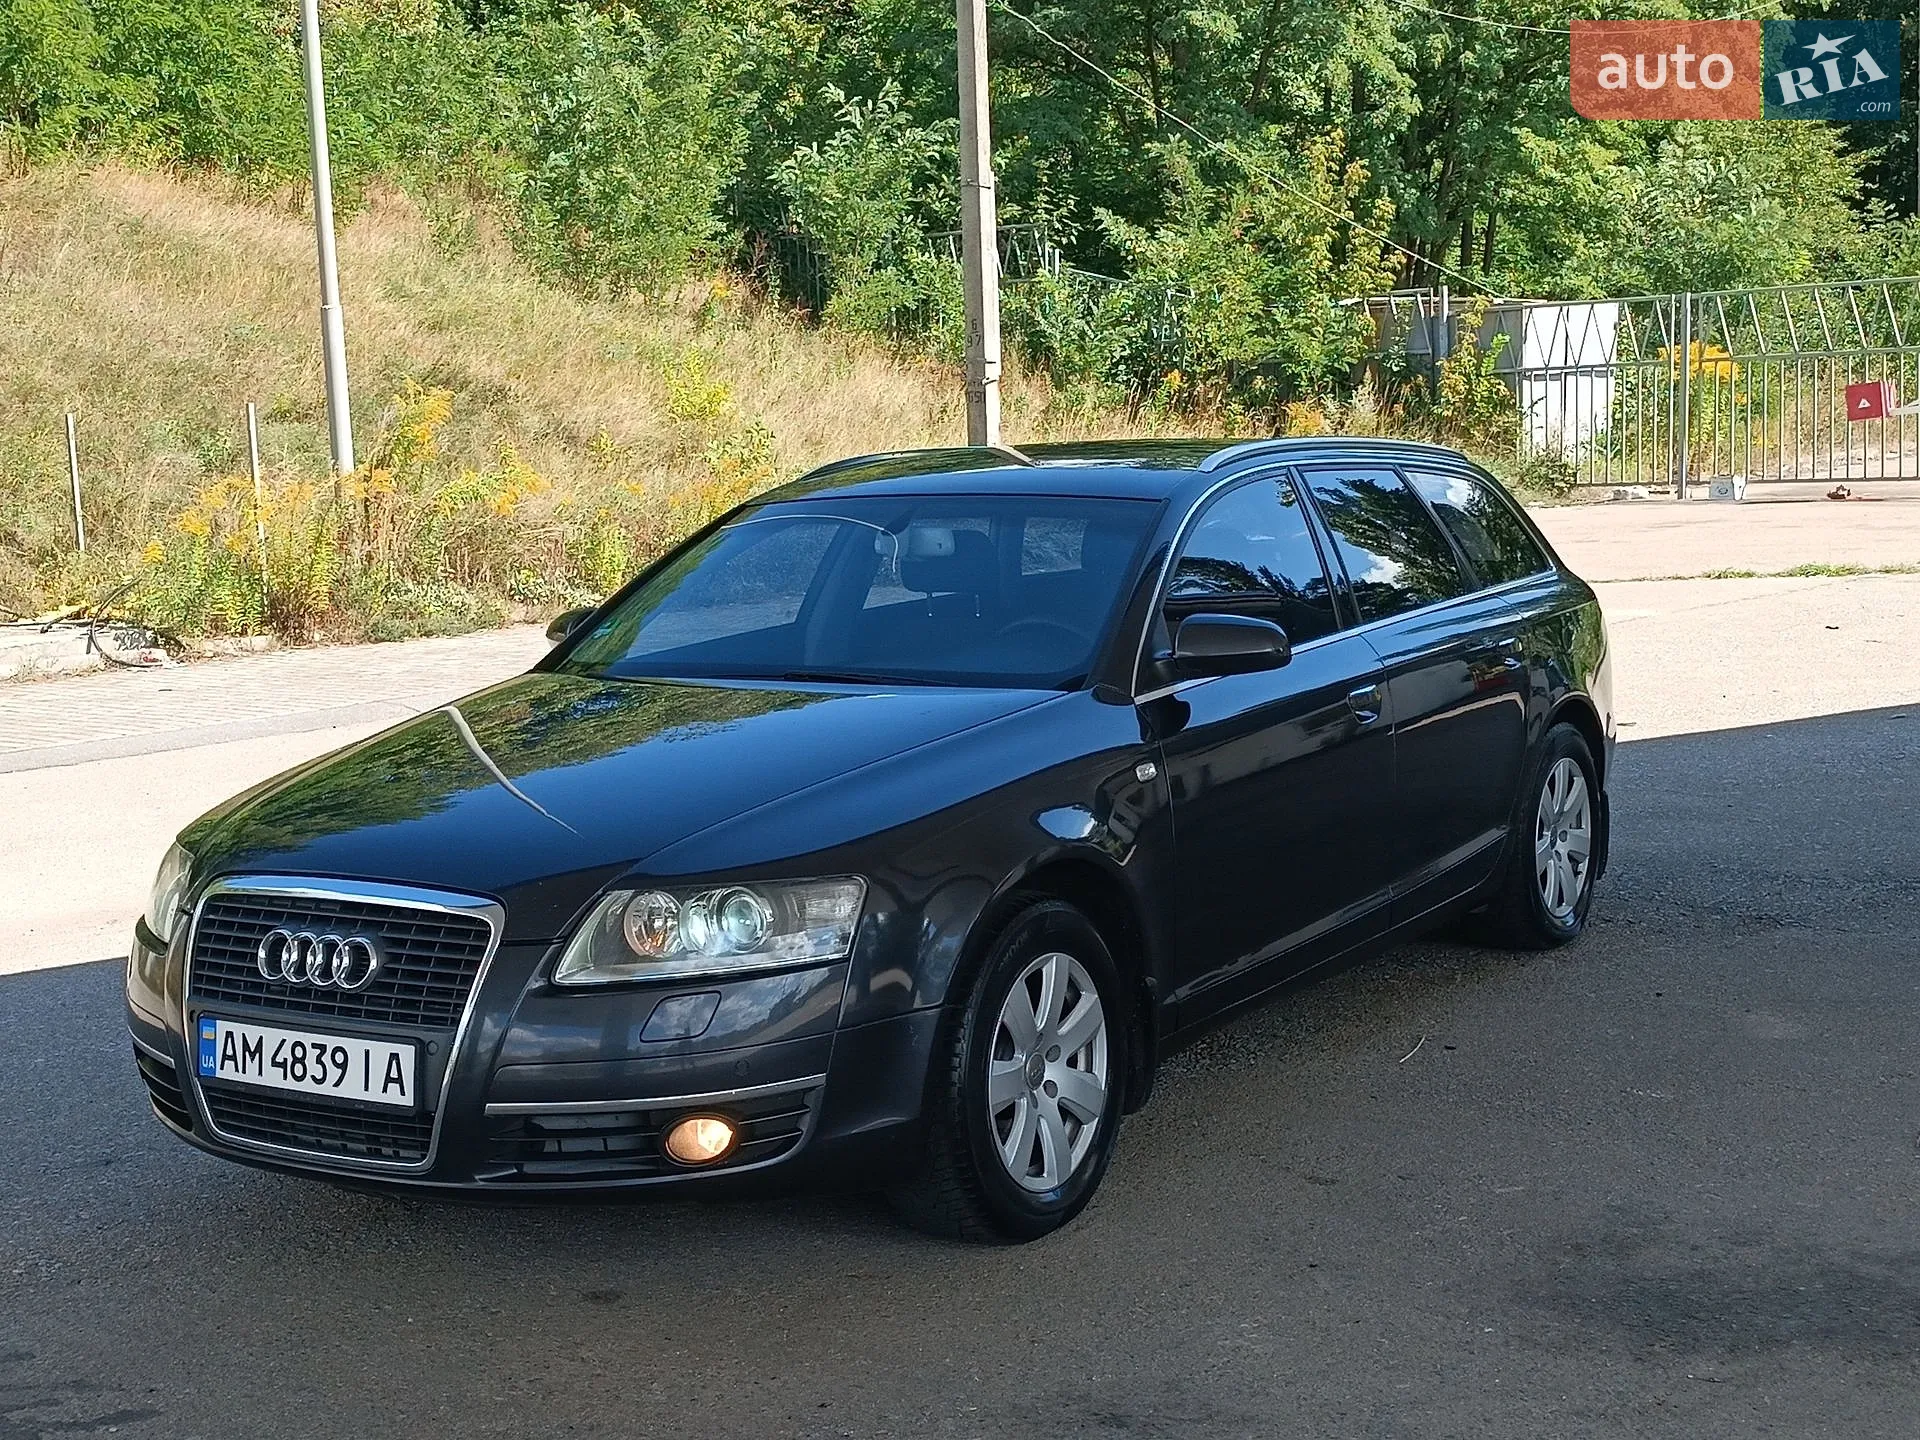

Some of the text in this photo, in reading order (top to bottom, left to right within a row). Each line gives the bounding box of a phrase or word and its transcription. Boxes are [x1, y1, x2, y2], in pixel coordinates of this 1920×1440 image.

[201, 1055, 215, 1069] UA
[219, 1031, 406, 1096] AM 4839 IA
